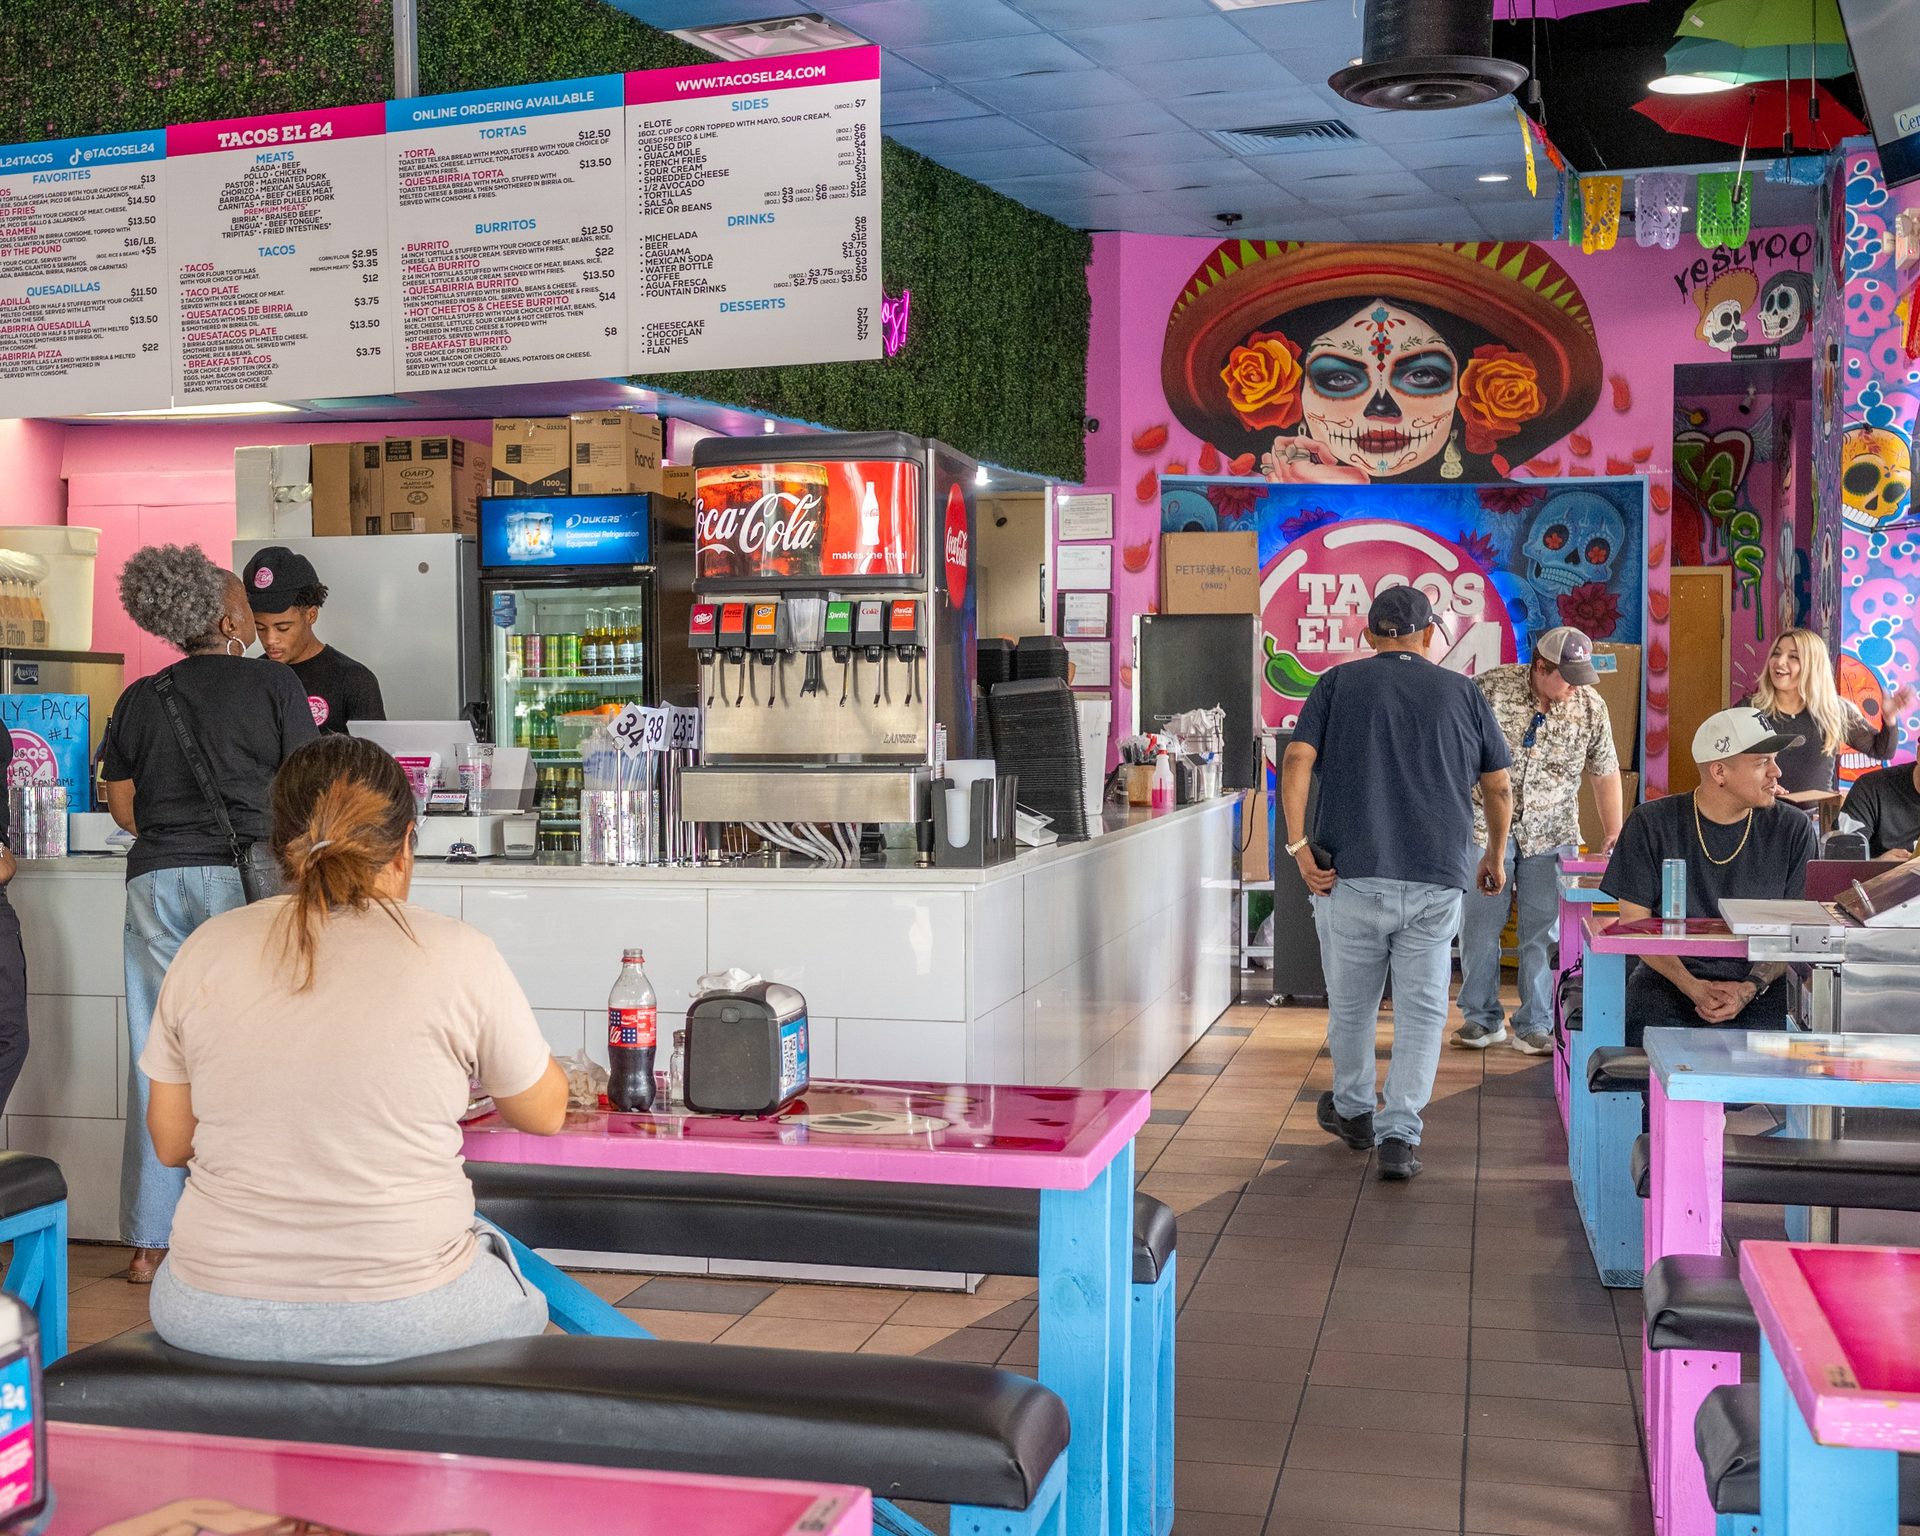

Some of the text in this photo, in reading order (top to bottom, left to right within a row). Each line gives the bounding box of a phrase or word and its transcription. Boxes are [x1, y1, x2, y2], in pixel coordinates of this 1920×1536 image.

[676, 66, 826, 92] WWW.TACOSEL24.COM
[413, 91, 594, 121] ONLINE ORDERING AVAILABLE
[732, 98, 769, 112] SIDES
[855, 98, 866, 108] $7
[638, 112, 832, 138] 16OZ. CUP OF CORN TOPPED WITH MAYO, SOUR CREAM,
[643, 118, 672, 129] ELOTE
[218, 122, 333, 148] TACOS EL 24
[479, 125, 527, 140] TORTAS
[578, 128, 611, 141] $12.50
[84, 144, 154, 161] @TACOSEL24
[643, 140, 693, 153] QUESO DIP
[256, 151, 295, 164] MEATS
[404, 148, 436, 159] TORTA
[643, 147, 701, 161] GUACAMOLE
[281, 161, 301, 170] BEEF
[579, 157, 612, 170] $13.50
[643, 155, 708, 169] FRENCH FRIES
[250, 164, 277, 173] ASADA
[274, 168, 307, 178] CHICKEN
[644, 163, 703, 177] SOUR CREAM
[33, 169, 91, 184] FAVORITES
[140, 174, 156, 184] $13
[244, 171, 269, 181] POLLO
[260, 172, 327, 186] MARINATED PORK
[404, 169, 505, 187] QUESABIRRIA TORTA
[644, 168, 730, 185] SHREDDED CHEESE
[225, 180, 255, 190] PASTOR
[644, 179, 705, 193] 1/2 AVOCADO
[643, 188, 693, 200] TORTILLAS
[127, 195, 156, 206] $14.50
[644, 198, 674, 208] SALSA
[128, 215, 156, 227] $13.50
[728, 212, 775, 227] DRINKS
[475, 218, 537, 234] BURRITOS
[581, 224, 614, 237] $12.50
[124, 236, 157, 248] $16/LB.
[645, 231, 698, 243] MICHELADA
[1, 244, 62, 258] BY THE POUND
[258, 244, 296, 257] TACOS
[407, 240, 450, 252] BURRITO
[595, 246, 614, 258] $22
[645, 241, 669, 251] BEER
[352, 248, 378, 260] $2.95
[645, 247, 692, 259] CAGUAMA
[352, 258, 379, 270] $3.35
[645, 253, 714, 267] MEXICAN SODA
[184, 262, 215, 273] TACOS
[408, 259, 481, 274] MEGA BURRITO
[644, 261, 713, 274] WATER BOTTLE
[362, 273, 379, 284] $12
[582, 269, 615, 281] $13.50
[645, 272, 681, 283] COFFEE
[26, 282, 101, 297] QUESADILLAS
[130, 287, 158, 297] $11.50
[185, 285, 240, 297] TACO PLATE
[408, 277, 519, 296] QUESABIRRIA BURRITO
[354, 296, 380, 307] $3.75
[598, 291, 616, 302] $14
[186, 303, 293, 320] QUESATACOS DE BIRRIA
[409, 295, 570, 317] HOT CHEETOS & CHEESE BURRITO
[720, 298, 786, 313] DESSERTS
[130, 314, 158, 326] $13.50
[349, 319, 380, 330] $13.50
[646, 319, 705, 332] CHEESECAKE
[187, 327, 278, 342] QUESATACOS PLATE
[646, 328, 702, 339] CHOCOFLAN
[646, 336, 689, 347] 3 LECHES
[142, 343, 159, 353] $22
[647, 346, 671, 355] FLAN
[495, 423, 516, 431] Karat
[634, 447, 656, 470] Karat
[404, 469, 430, 477] DART
[582, 515, 620, 523] DUKERS
[566, 530, 640, 539] Commercial Refrigeration
[566, 540, 598, 548] Equipment
[832, 551, 863, 560] makes
[828, 611, 849, 619] Sprite
[1296, 618, 1354, 652] EL
[165, 696, 193, 750] LOUIS VUITTON
[672, 712, 687, 742] 23
[47, 727, 73, 741] #1
[616, 712, 645, 749] 34
[646, 715, 664, 744] 38
[882, 733, 918, 743] LANCER
[2, 1383, 26, 1411] 24
